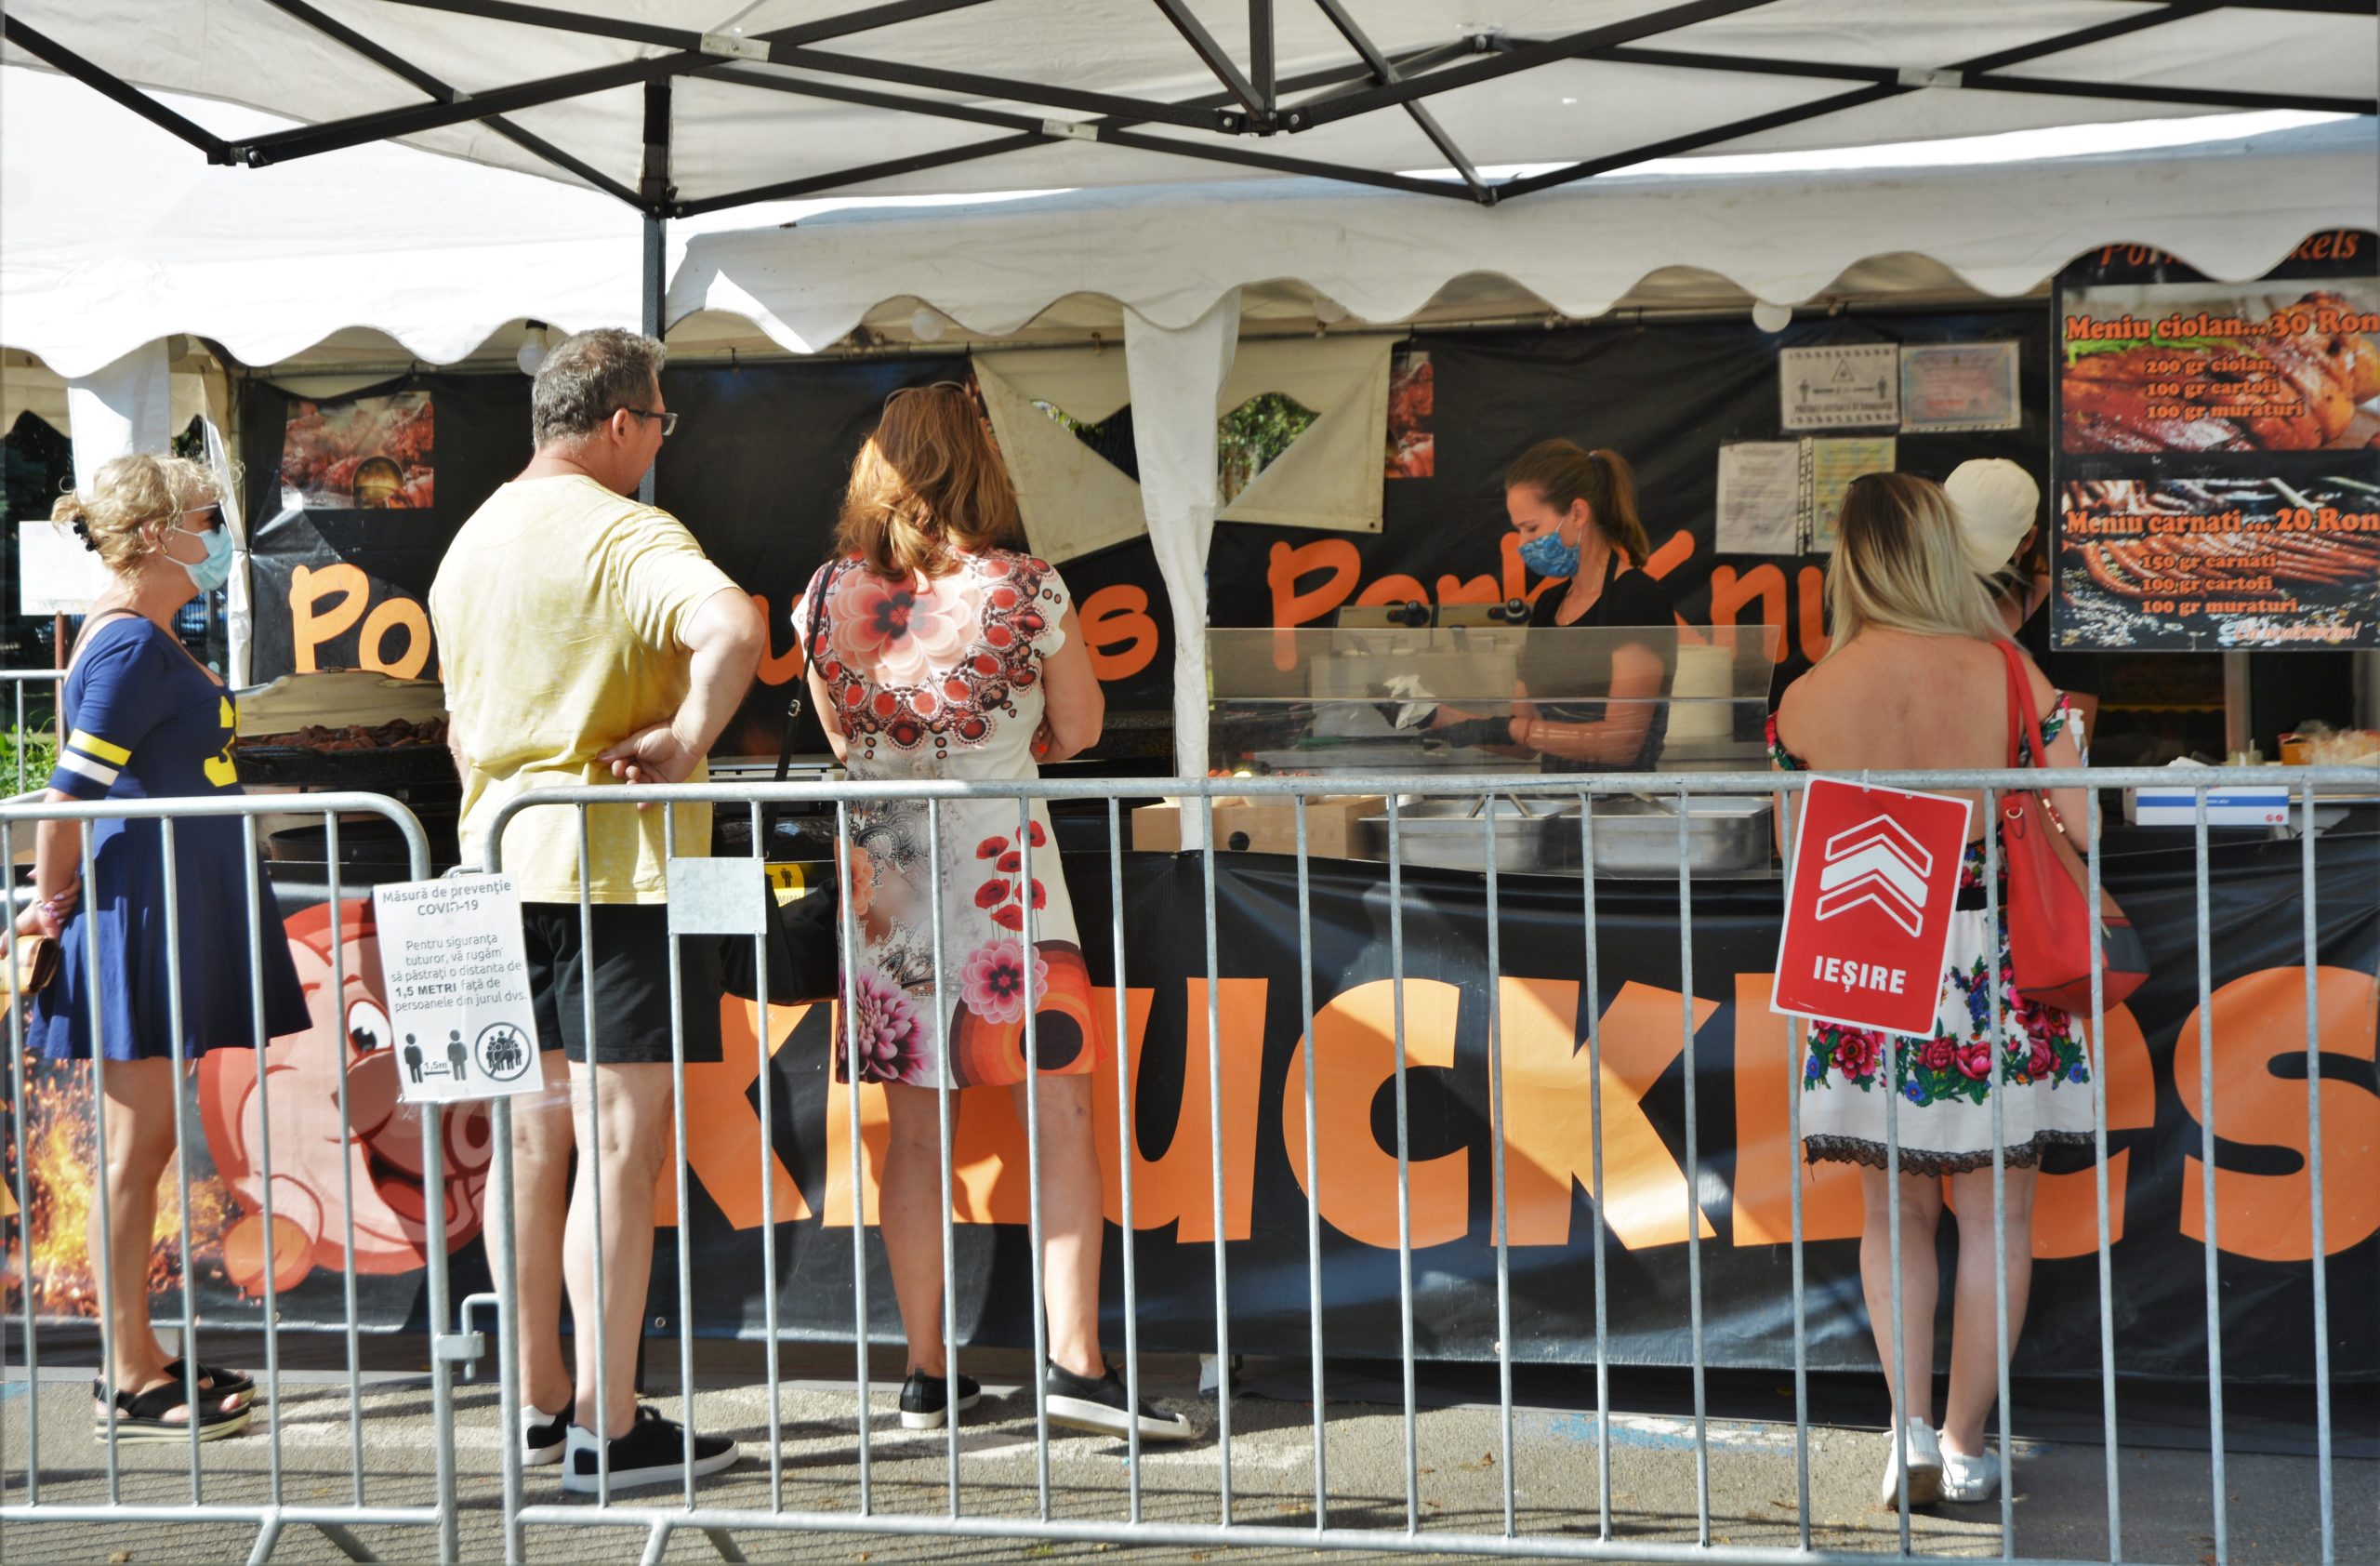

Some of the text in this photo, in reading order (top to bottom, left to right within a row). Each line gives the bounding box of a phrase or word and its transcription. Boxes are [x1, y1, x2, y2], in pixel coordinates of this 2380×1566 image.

[2067, 314, 2152, 340] Meniu
[2270, 312, 2310, 338] 30
[2316, 307, 2380, 335] Ron
[2144, 359, 2181, 374] 200
[2185, 359, 2207, 375] gr
[2147, 378, 2280, 399] 100 gr cartofi
[2147, 400, 2306, 421] 100 gr muraturi
[2066, 510, 2144, 534] Meniu
[2149, 510, 2241, 533] carnati
[2276, 507, 2313, 532] 20
[2317, 507, 2380, 532] Ron
[2142, 552, 2277, 571] 150 gr carnati
[2142, 575, 2273, 594] 100 gr cartofi
[2142, 597, 2298, 617] 100 gr muraturi
[383, 880, 511, 903] Măsură de prevenție
[406, 934, 498, 950] Pentru siguranța
[405, 948, 502, 966] tuturor, vă rugăm
[391, 971, 403, 982] să
[405, 968, 446, 982] păstrați
[450, 968, 456, 976] o
[508, 961, 522, 972] de
[1813, 955, 1906, 994] IEȘIRE
[395, 986, 414, 999] 1,5
[418, 983, 456, 995] METRI
[486, 977, 500, 989] de
[395, 990, 527, 1012] persoanele din jurul dvs.
[425, 1061, 447, 1070] 1,5m
